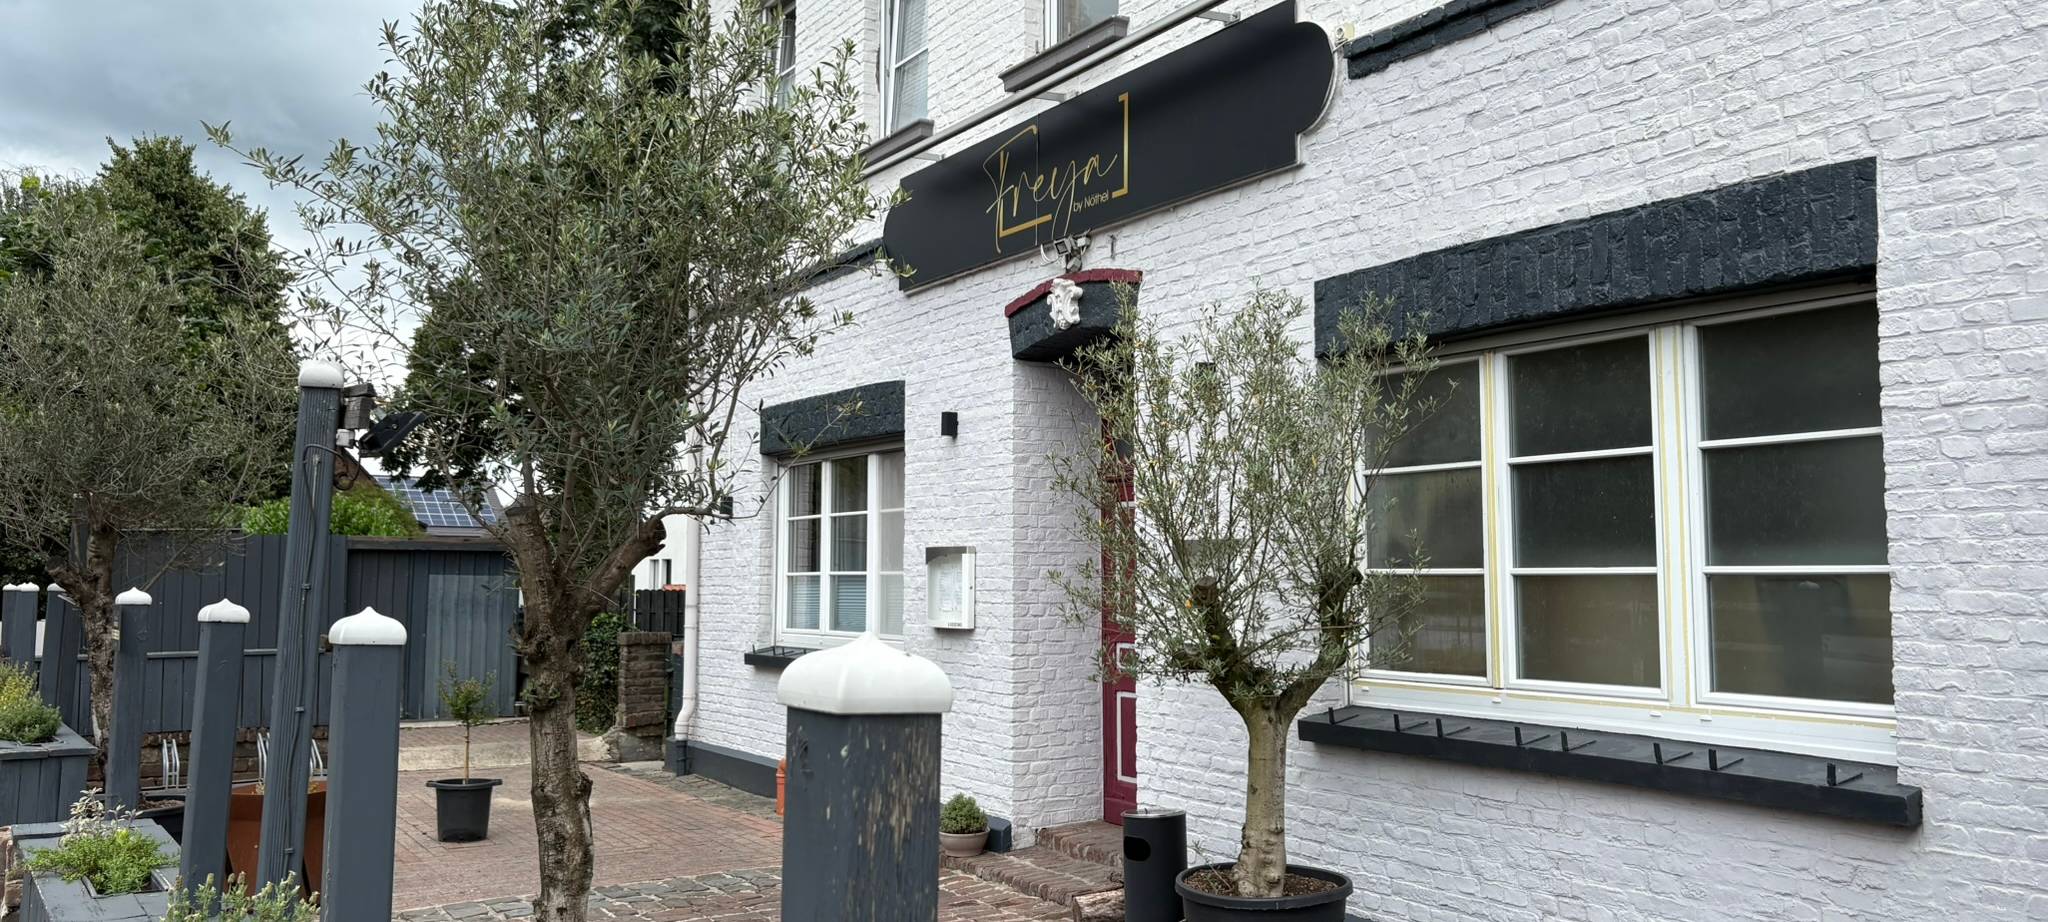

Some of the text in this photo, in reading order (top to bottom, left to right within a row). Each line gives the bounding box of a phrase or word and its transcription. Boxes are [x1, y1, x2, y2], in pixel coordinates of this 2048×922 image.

[983, 124, 1118, 254] Freya
[1072, 189, 1110, 213] by Nöthel
